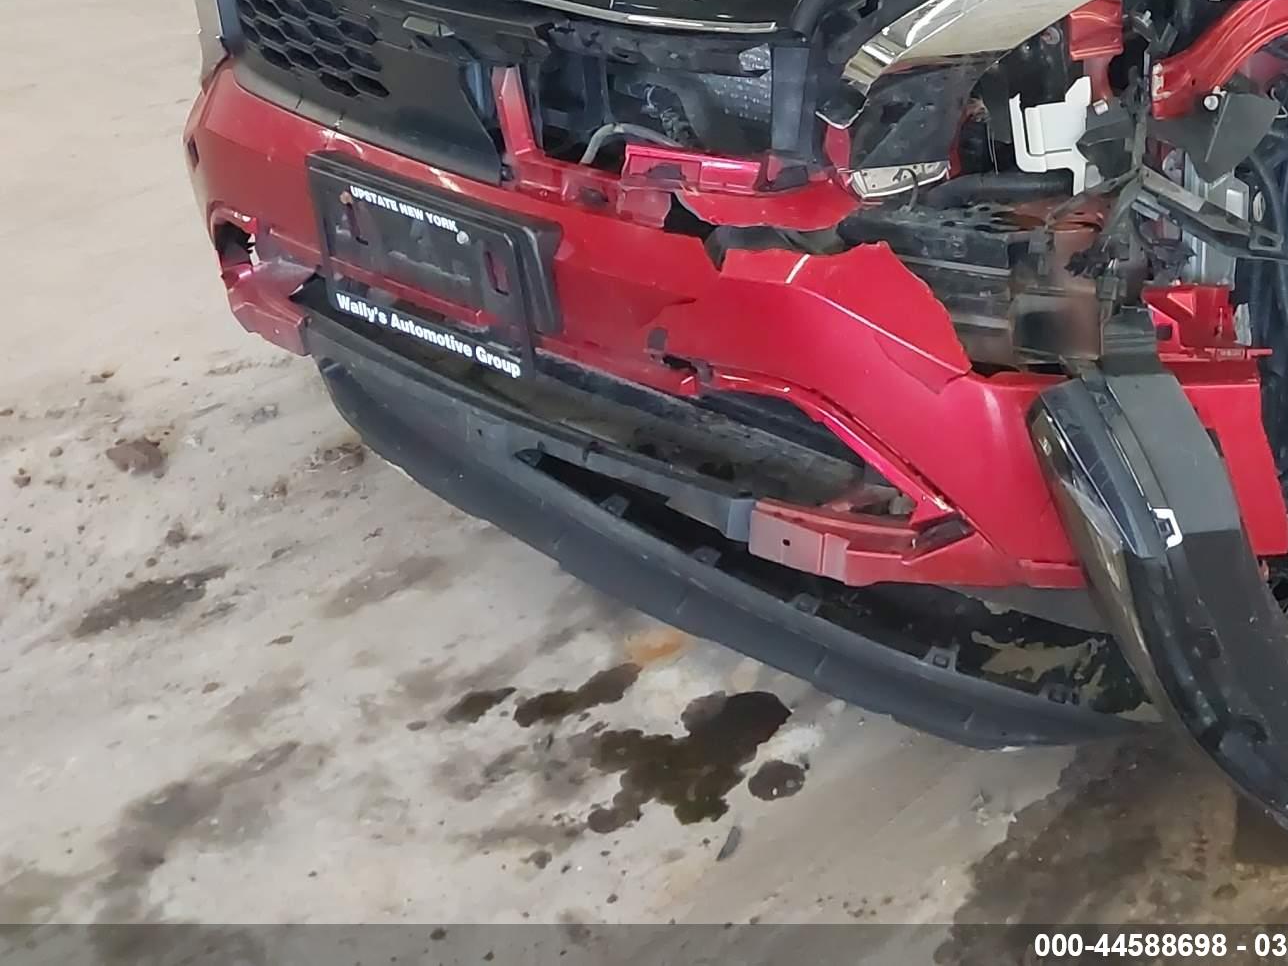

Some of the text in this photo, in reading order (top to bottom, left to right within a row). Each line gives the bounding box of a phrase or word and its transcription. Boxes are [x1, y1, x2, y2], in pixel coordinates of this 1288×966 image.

[350, 185, 459, 233] UPSTATE NEW YORK
[336, 293, 521, 379] Wally's Automotive Group
